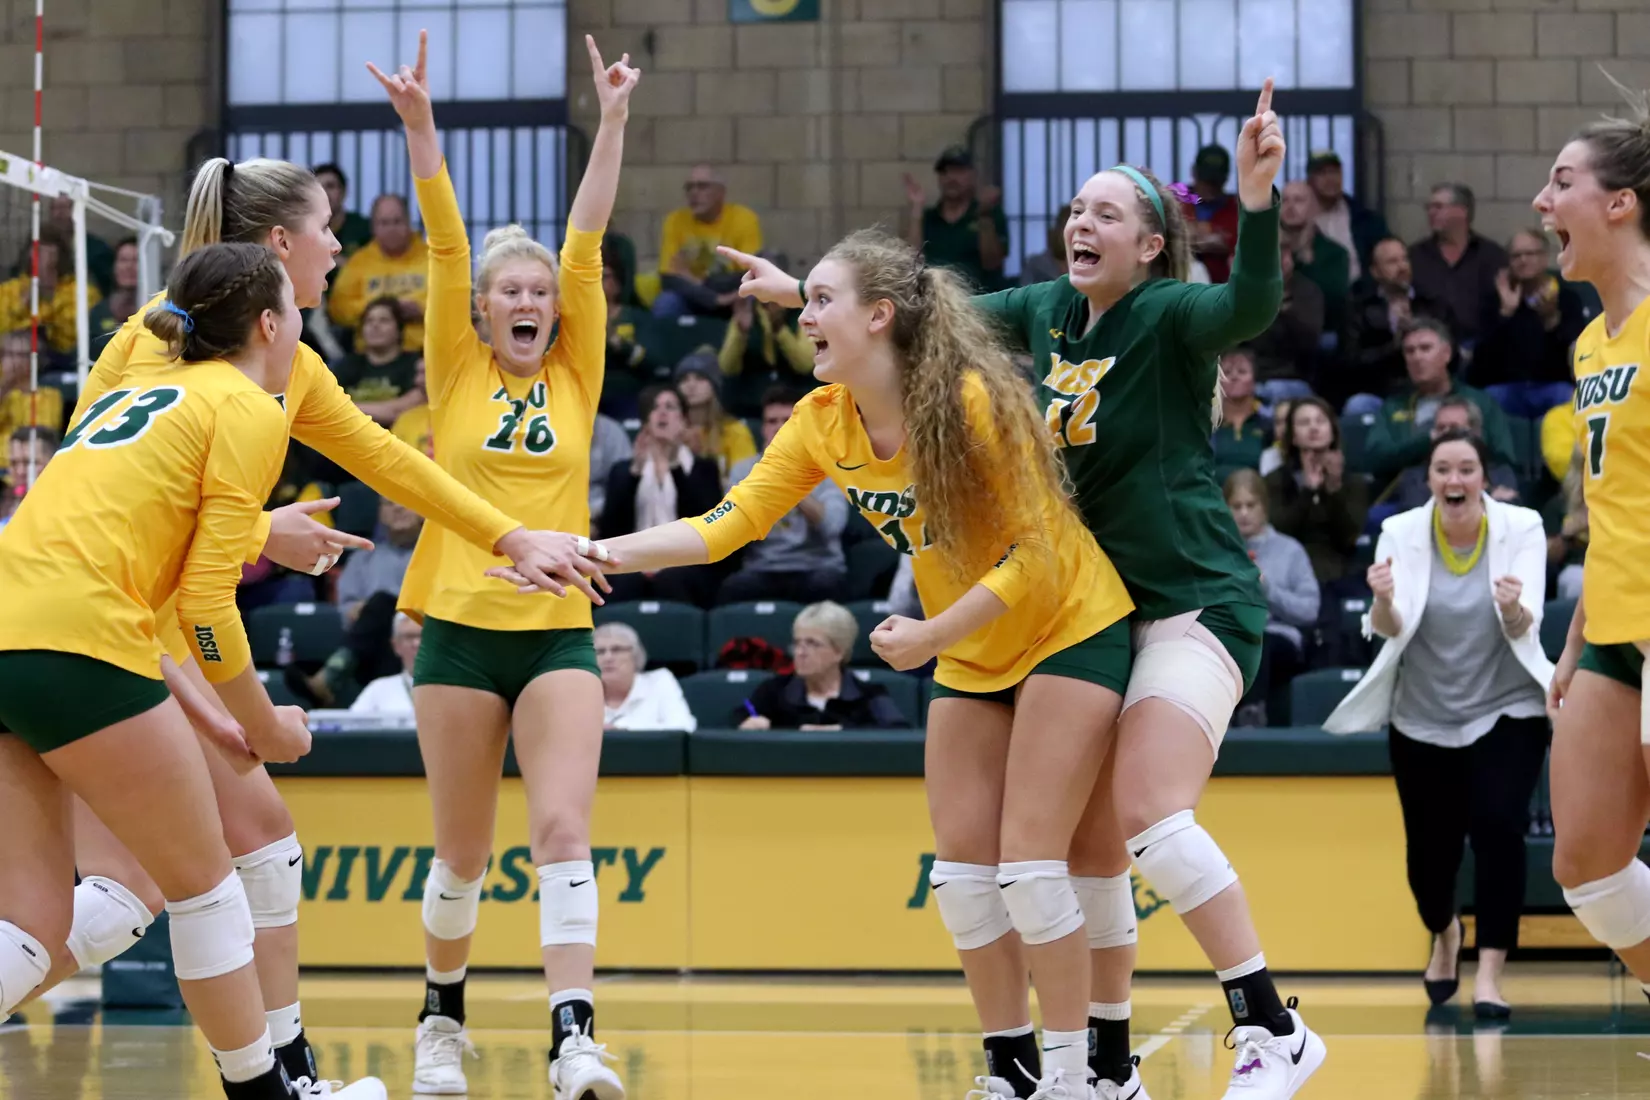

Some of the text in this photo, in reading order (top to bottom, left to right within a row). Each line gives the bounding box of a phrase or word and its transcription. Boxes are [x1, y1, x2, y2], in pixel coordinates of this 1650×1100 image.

[1574, 364, 1638, 413] NDSU
[56, 386, 186, 453] 13
[483, 411, 557, 456] 16
[1586, 412, 1610, 479] 1
